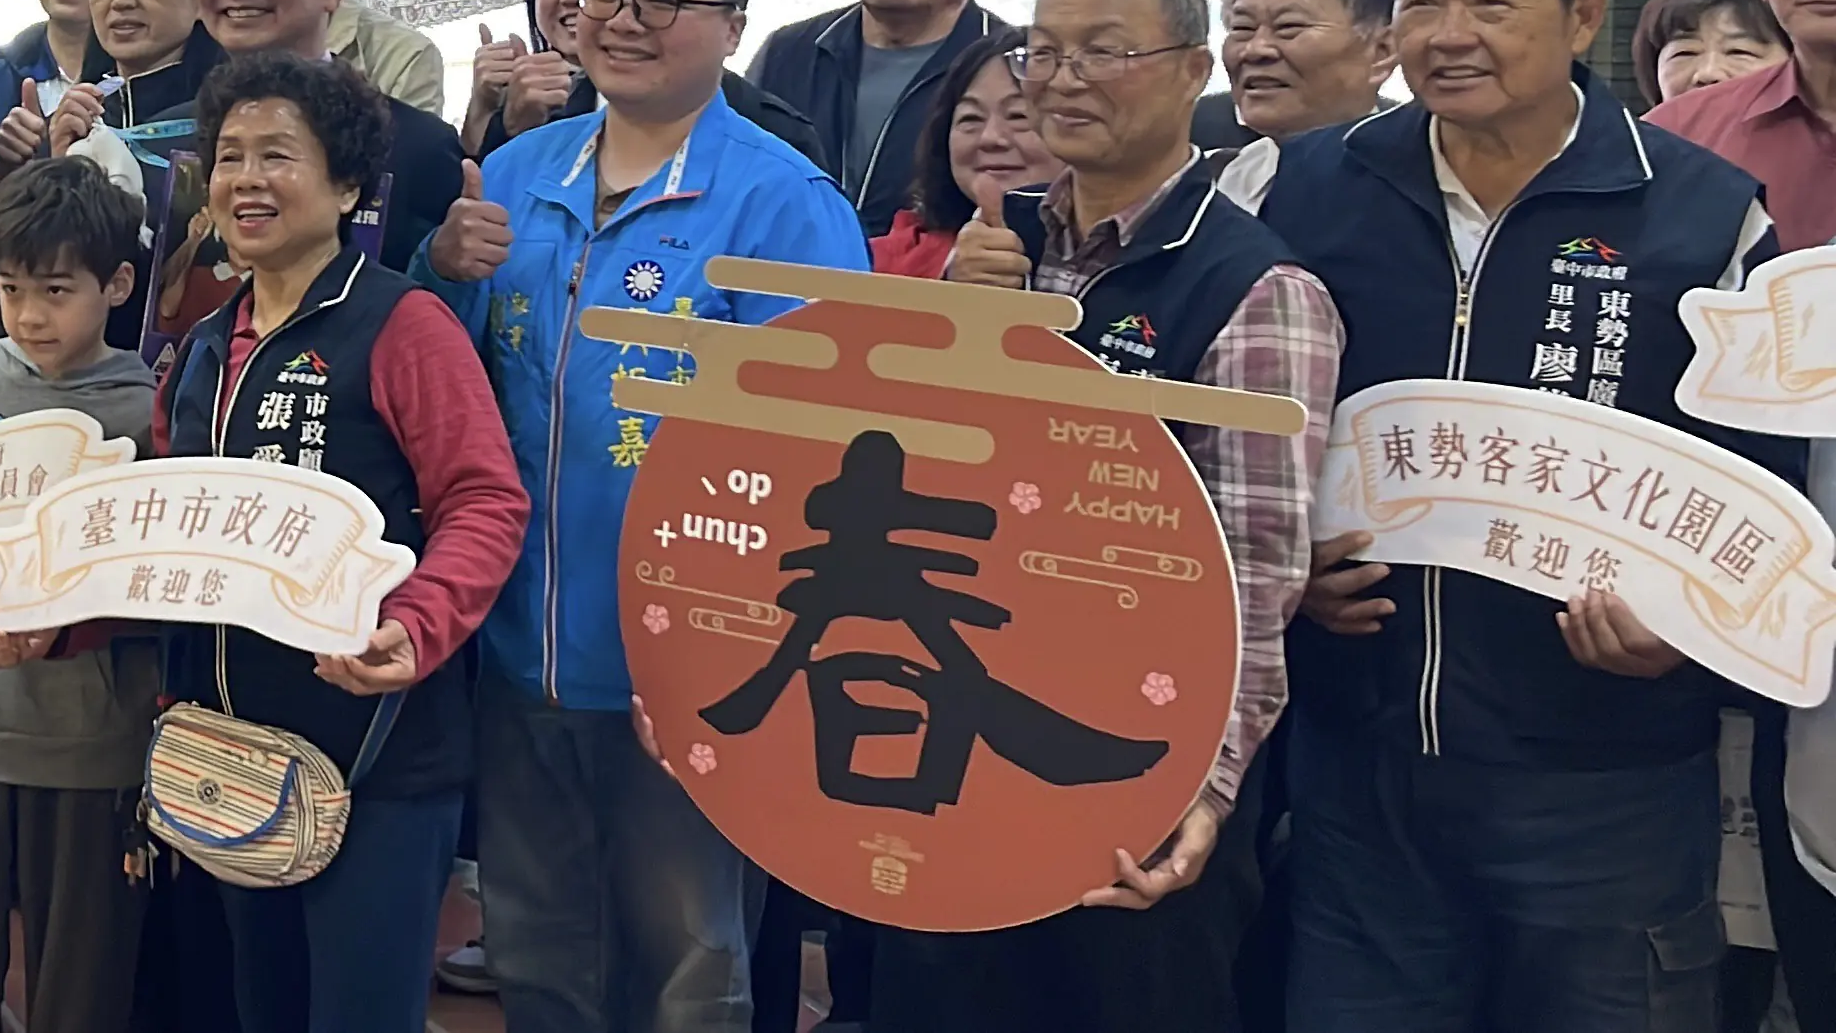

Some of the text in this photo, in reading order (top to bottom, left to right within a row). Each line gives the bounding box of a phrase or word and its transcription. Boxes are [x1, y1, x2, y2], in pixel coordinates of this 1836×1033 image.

[1047, 417, 1140, 453] YEAR
[1088, 459, 1160, 492] NEW
[1377, 421, 1777, 584] 東勢客家文化園區
[79, 485, 318, 559] 臺中市政府
[1063, 494, 1181, 531] HAPPY
[127, 563, 230, 607] 歡迎您
[1483, 517, 1624, 596] 歡迎您
[696, 430, 1170, 816] 春
